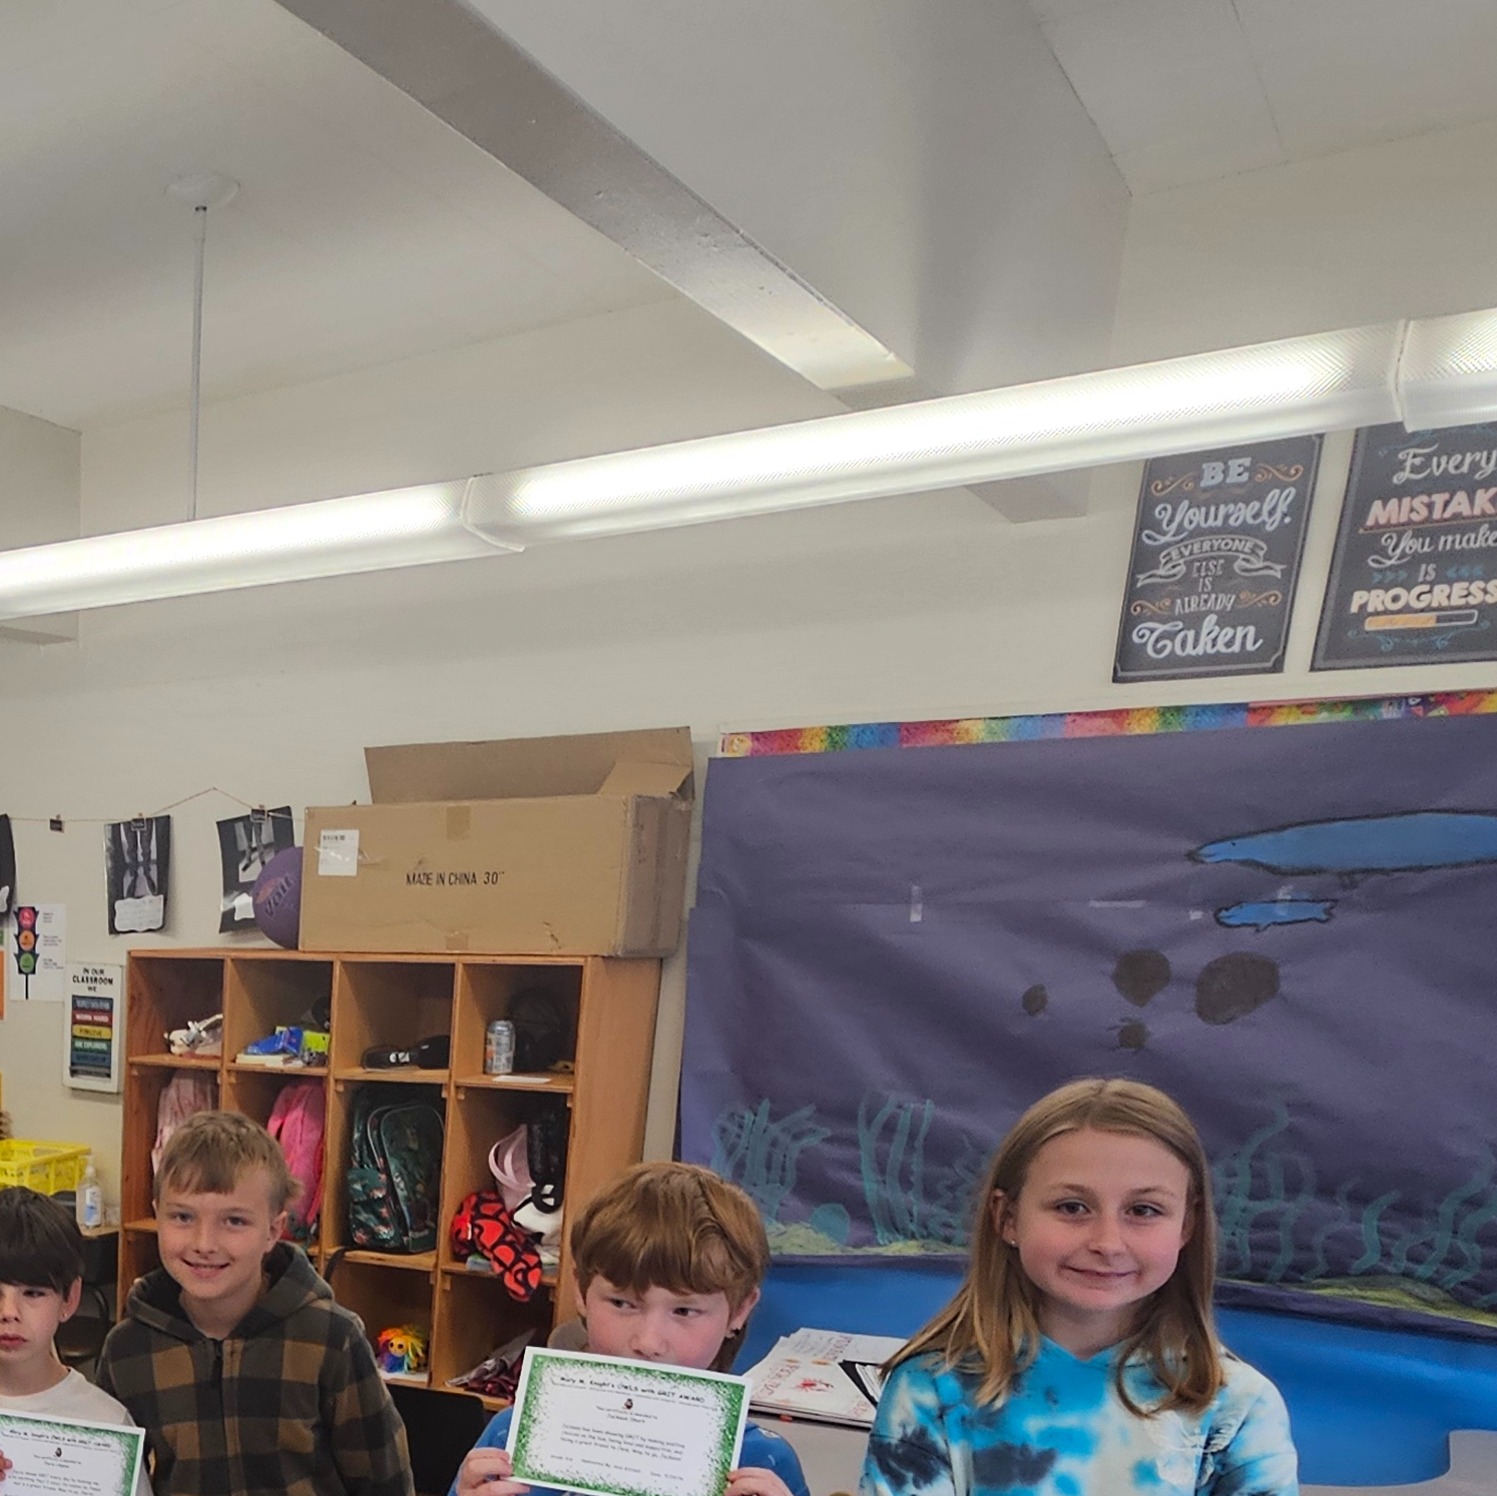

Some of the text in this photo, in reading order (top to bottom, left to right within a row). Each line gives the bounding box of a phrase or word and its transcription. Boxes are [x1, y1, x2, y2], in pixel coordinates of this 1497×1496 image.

[1200, 457, 1252, 487] BE
[1393, 443, 1497, 484] Every
[1172, 538, 1254, 560] EVERYONE
[1367, 530, 1434, 568] You
[1193, 559, 1224, 577] ELSE
[1418, 563, 1436, 582] IS
[1198, 577, 1212, 592] IS
[1175, 593, 1236, 615] ALREADY
[1351, 579, 1497, 613] PROGRESS
[1132, 613, 1263, 658] Taken
[406, 872, 433, 886] MADE
[436, 872, 445, 886] IN
[449, 872, 477, 886] CHINA
[72, 975, 113, 985] CLASSROOM
